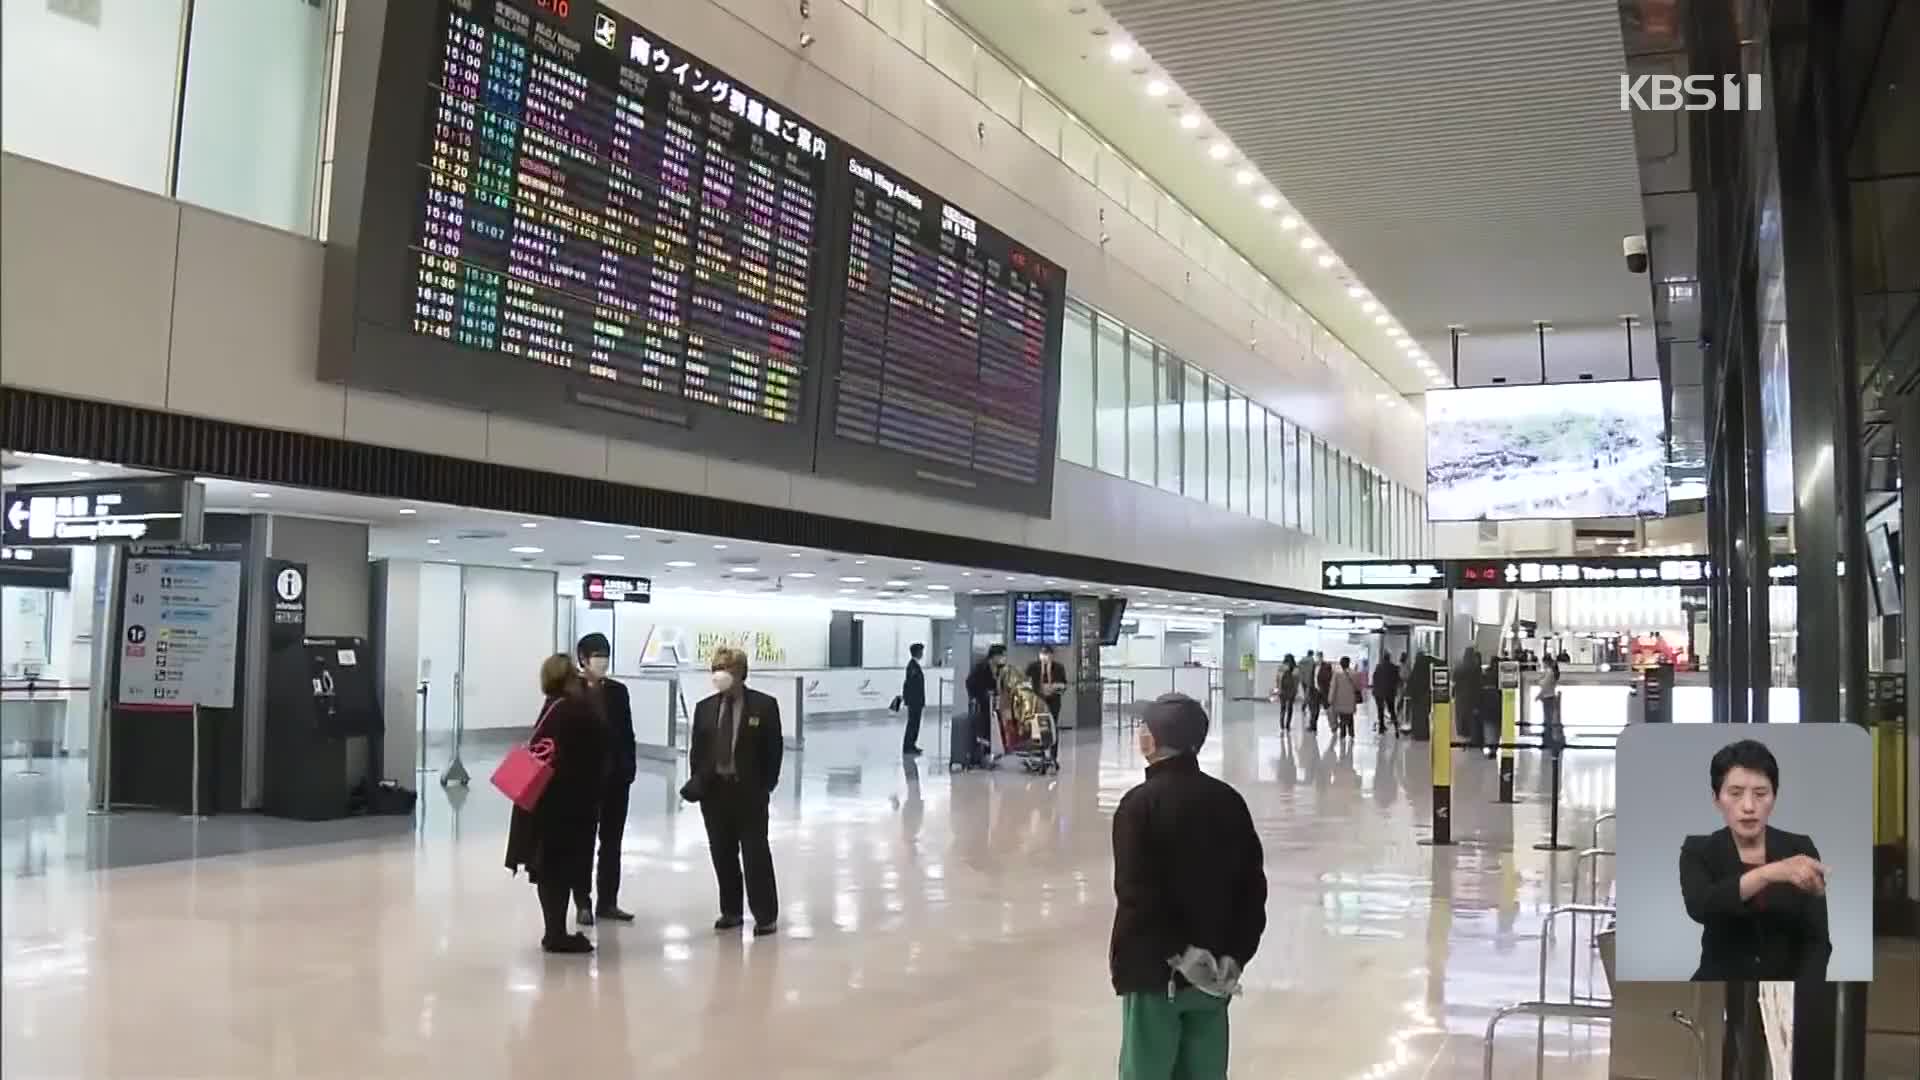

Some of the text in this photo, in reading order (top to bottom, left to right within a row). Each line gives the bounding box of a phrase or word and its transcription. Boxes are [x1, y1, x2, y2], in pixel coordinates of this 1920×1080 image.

[448, 28, 482, 53] 14:30
[531, 67, 586, 102] SINGAPORE
[450, 13, 484, 38] 14:30
[533, 53, 588, 88] SINGAPORE
[444, 60, 479, 84] 15:00
[526, 97, 565, 120] MANILA
[613, 136, 630, 150] ANA
[446, 44, 480, 68] 15:00
[528, 82, 574, 110] CHICAGO
[614, 123, 631, 137] ANA
[522, 142, 560, 165] NEWARK
[608, 178, 642, 200] UNITED
[524, 127, 568, 153] BANGKOK
[611, 164, 631, 180] THAI
[849, 158, 873, 182] South
[874, 171, 894, 197] Wing
[431, 172, 466, 194] 15:30
[515, 203, 534, 218] SAN
[541, 212, 597, 240] FRANCISCO
[602, 235, 637, 254] UNITED
[513, 217, 564, 243] BRUSSELS
[517, 187, 536, 202] SAN
[544, 196, 599, 225] FRANCISCO
[604, 221, 621, 233] ANA
[425, 221, 460, 242] 15:40
[510, 249, 542, 267] KUALA
[599, 278, 615, 289] ANA
[427, 205, 462, 226] 15:40
[512, 234, 557, 256] JAKARTA
[600, 263, 616, 276] ANA
[505, 295, 564, 319] VANCOUVER
[507, 279, 534, 295] GUAM
[508, 264, 560, 287] HONOLULU
[598, 291, 637, 310] TURKISH
[502, 326, 521, 339] LOS
[529, 333, 573, 352] ANGELES
[592, 351, 608, 362] ANA
[504, 311, 563, 334] VANCOUVER
[501, 341, 520, 354] LOS
[527, 348, 571, 368] ANGELES
